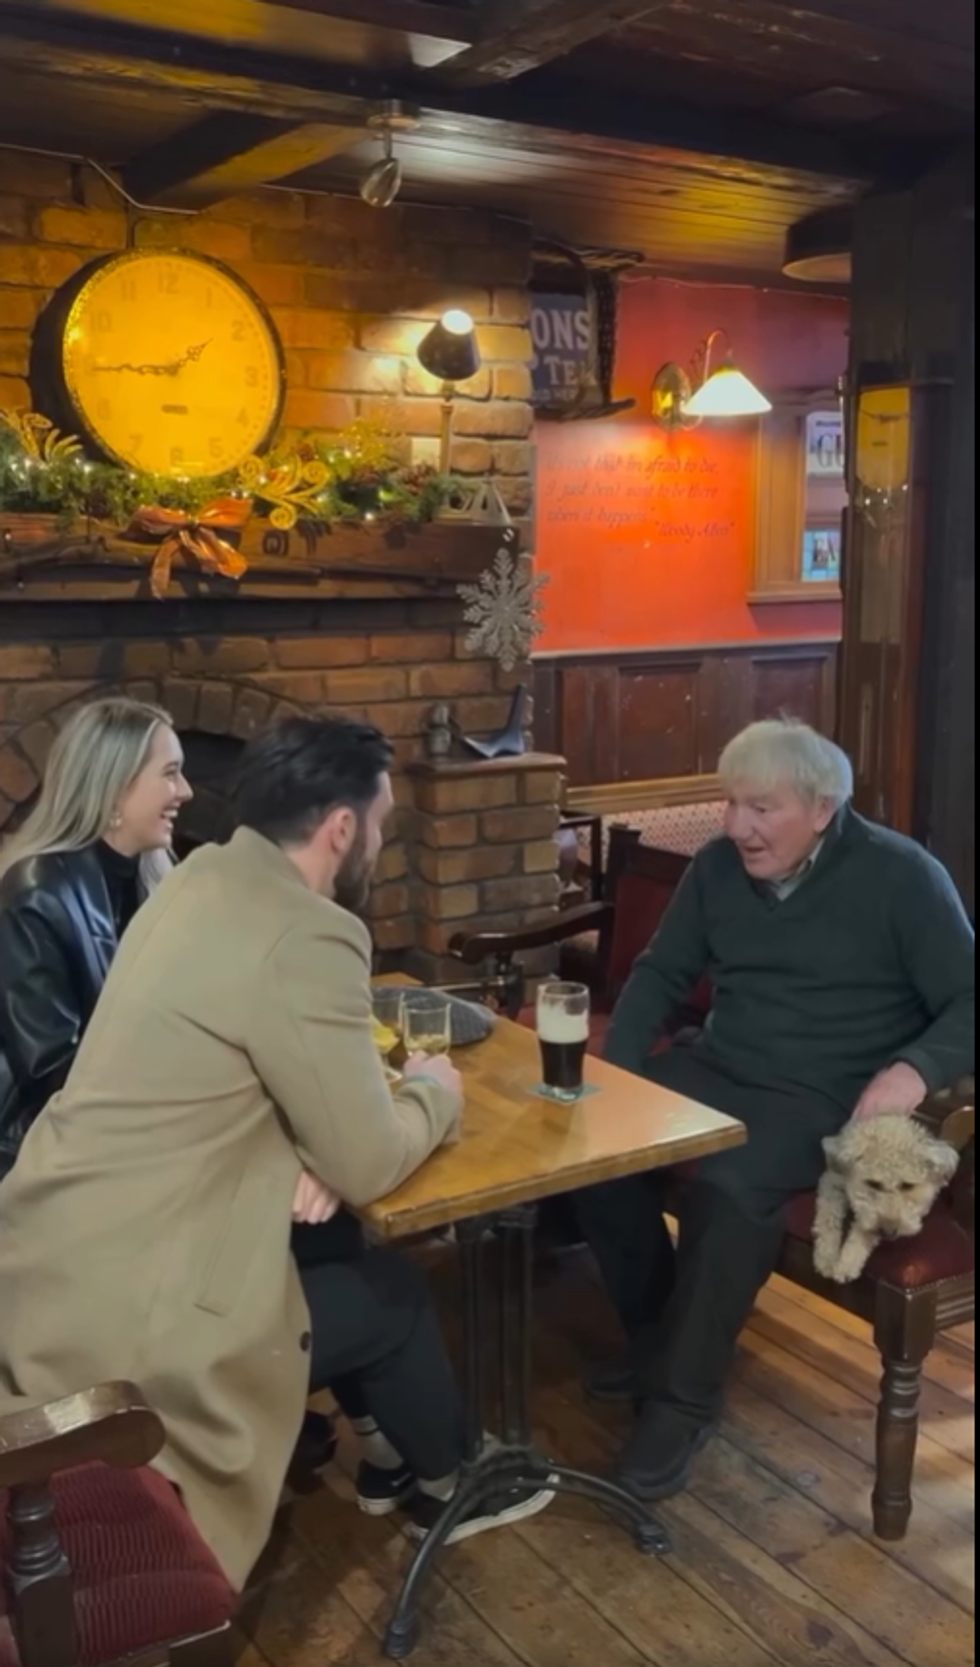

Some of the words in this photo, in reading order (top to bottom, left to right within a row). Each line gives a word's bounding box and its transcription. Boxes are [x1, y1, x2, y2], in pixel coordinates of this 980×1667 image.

[121, 280, 136, 302] 11
[157, 271, 179, 294] 12
[205, 287, 213, 308] 1
[88, 311, 112, 332] 10
[230, 319, 245, 341] 2
[244, 365, 258, 388] 3
[235, 406, 249, 428] 4
[128, 433, 144, 451] 7
[208, 436, 223, 459] 5
[644, 454, 681, 480] afraid
[556, 481, 589, 502] just
